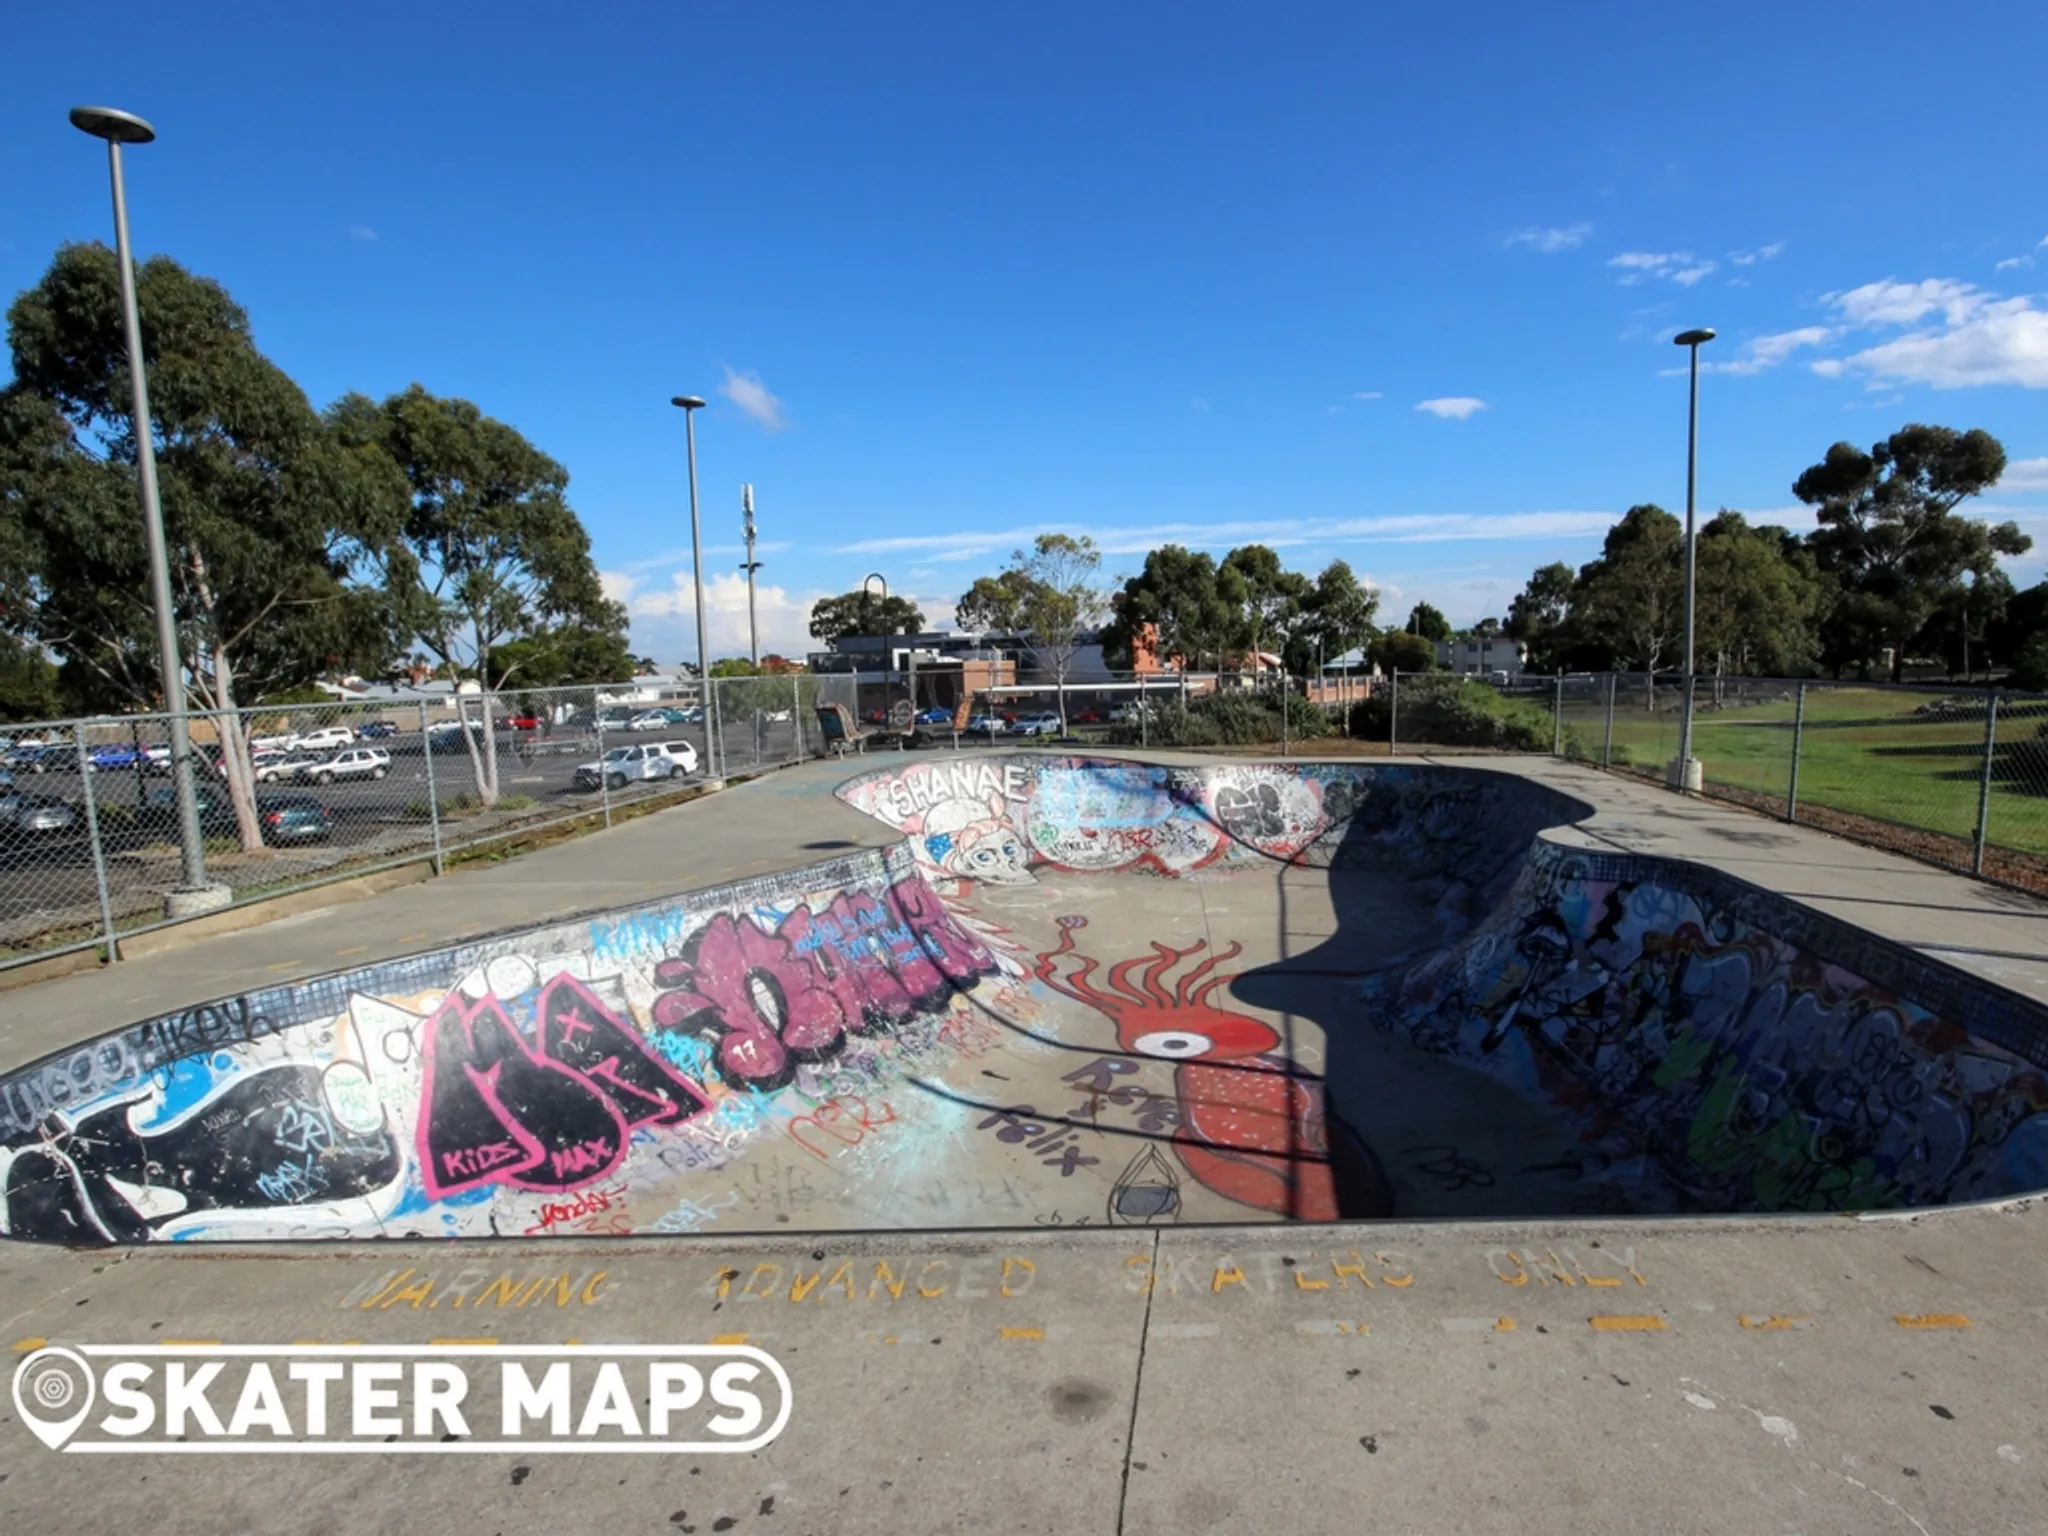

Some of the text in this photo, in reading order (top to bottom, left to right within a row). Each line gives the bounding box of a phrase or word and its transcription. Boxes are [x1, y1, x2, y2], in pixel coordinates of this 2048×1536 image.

[890, 763, 1028, 816] SHANAE
[551, 1136, 613, 1178] MAX
[336, 1246, 1649, 1310] WARNING ADVANCED SKATERS ONLY
